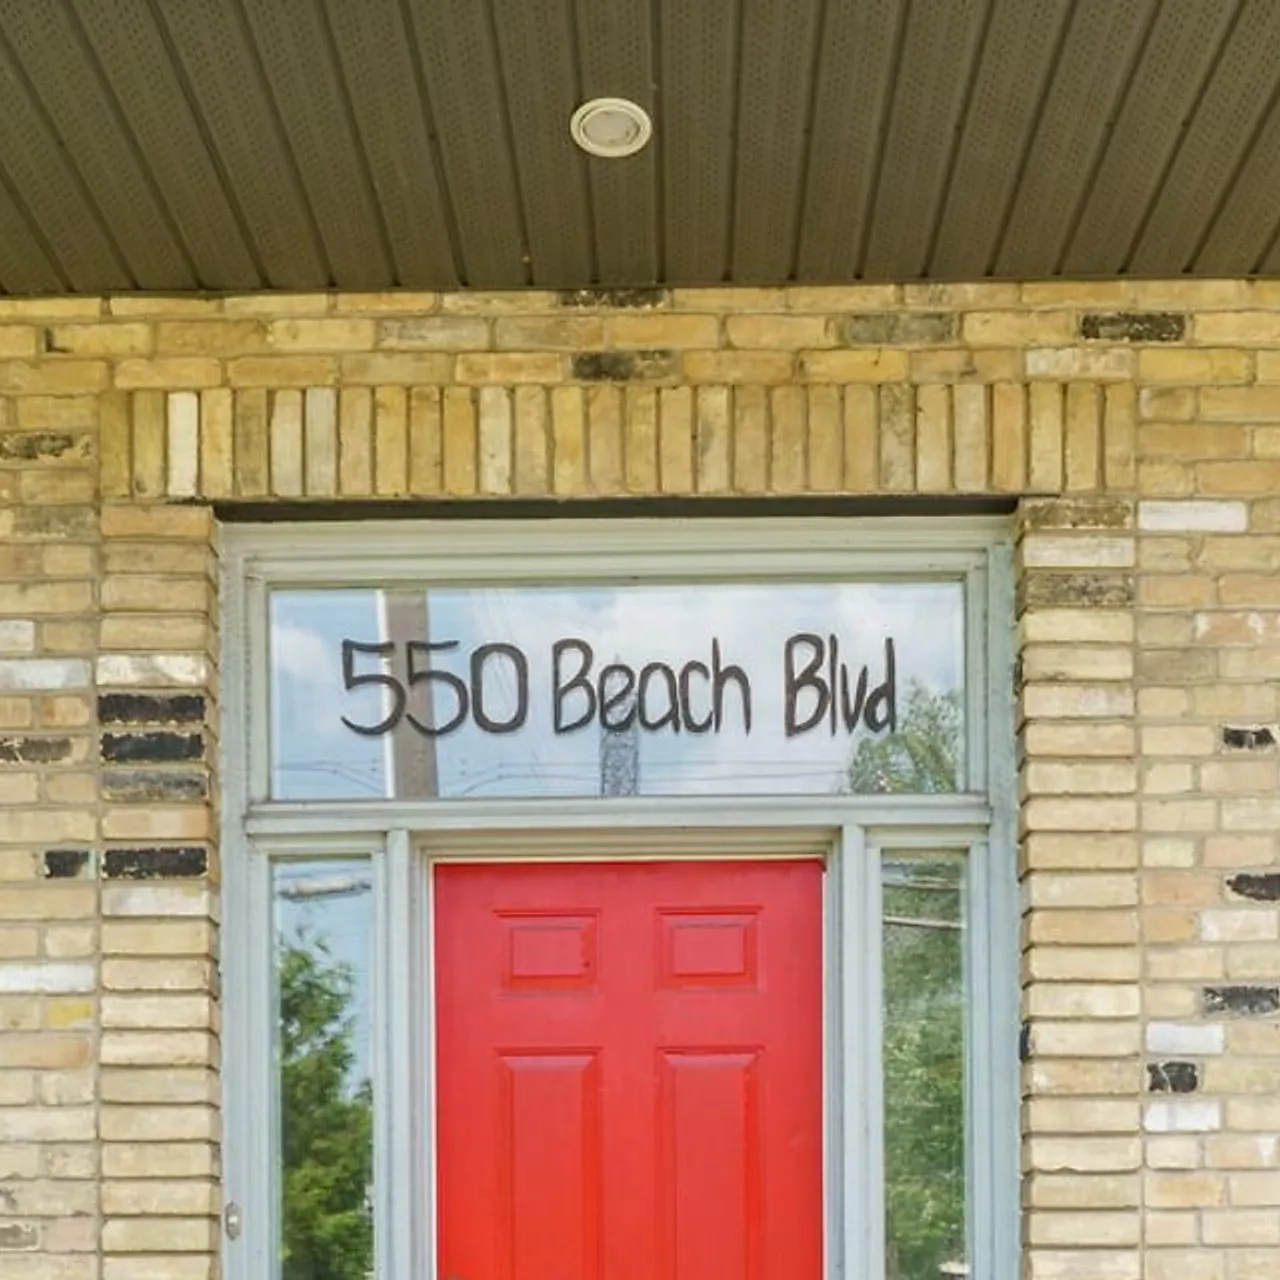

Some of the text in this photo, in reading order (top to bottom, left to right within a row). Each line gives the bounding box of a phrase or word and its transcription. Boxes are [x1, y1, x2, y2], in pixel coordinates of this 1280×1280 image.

[340, 632, 897, 738] 550 Beach Blvd
